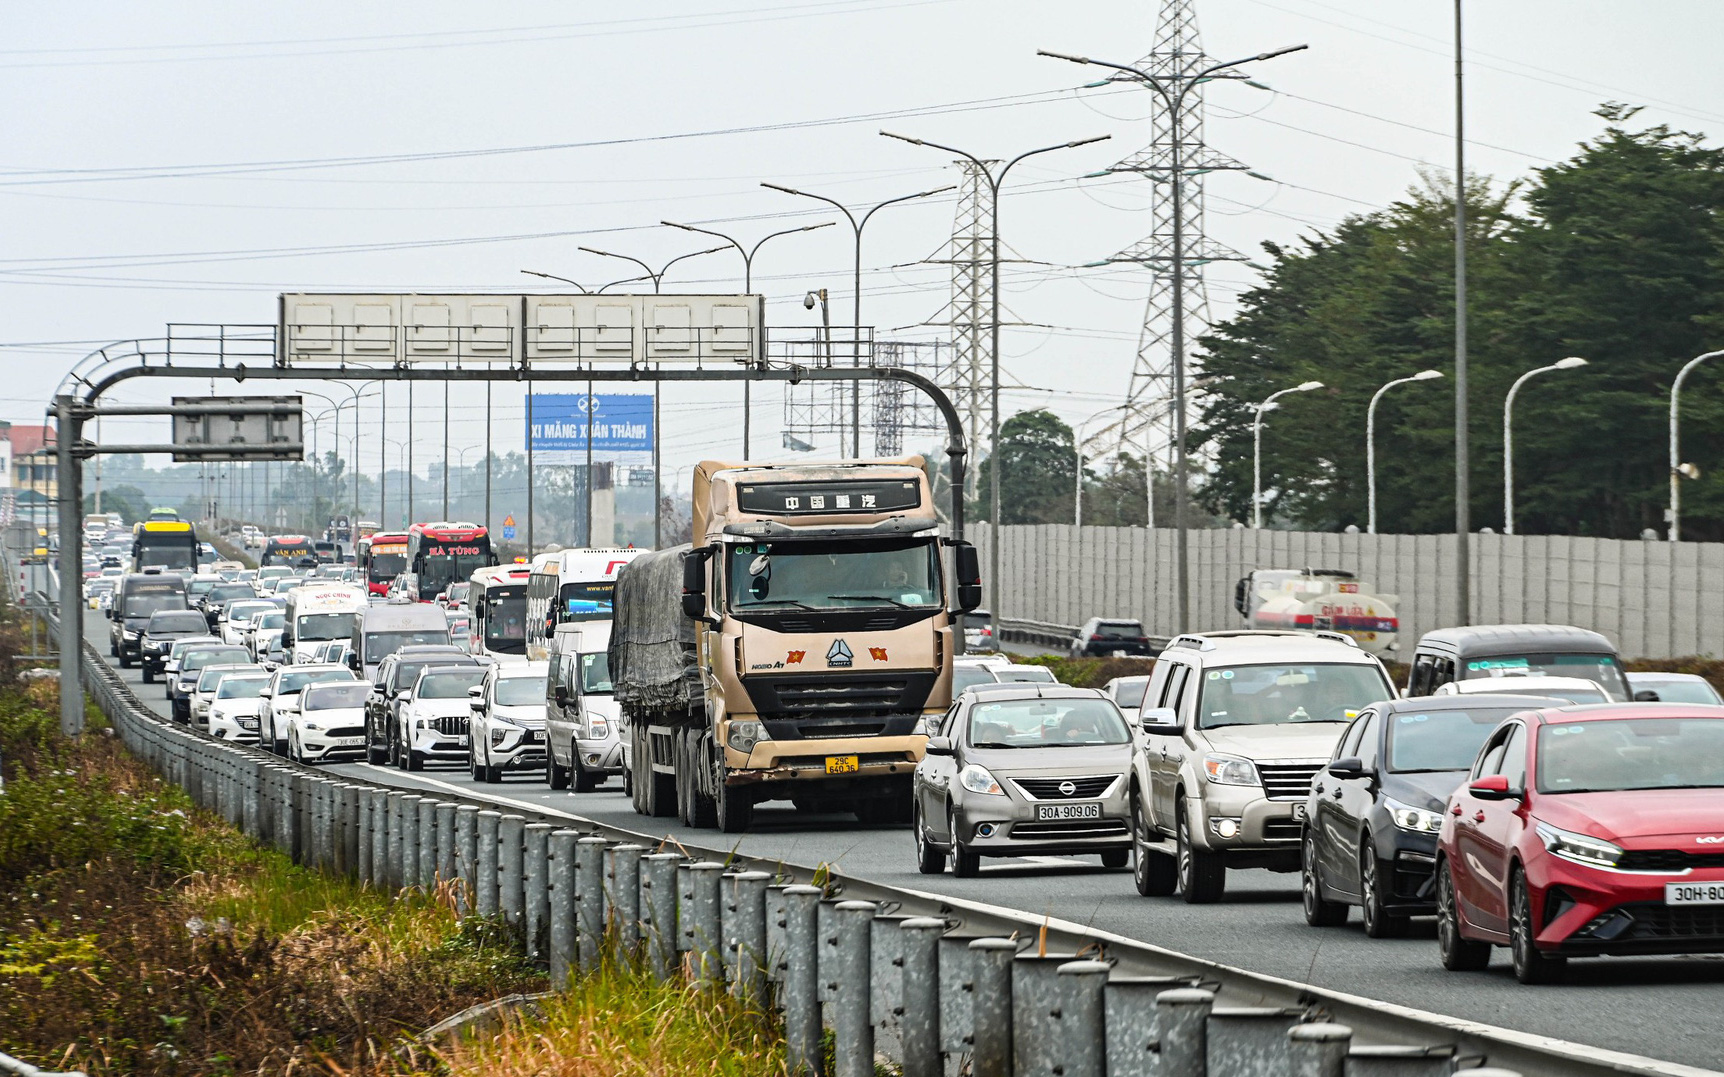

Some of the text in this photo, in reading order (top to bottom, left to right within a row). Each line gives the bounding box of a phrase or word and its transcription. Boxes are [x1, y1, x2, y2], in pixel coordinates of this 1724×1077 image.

[544, 420, 577, 438] MĂNG
[611, 421, 646, 439] THÀNH
[834, 757, 849, 765] 29C
[1040, 805, 1098, 818] 30A-909.06
